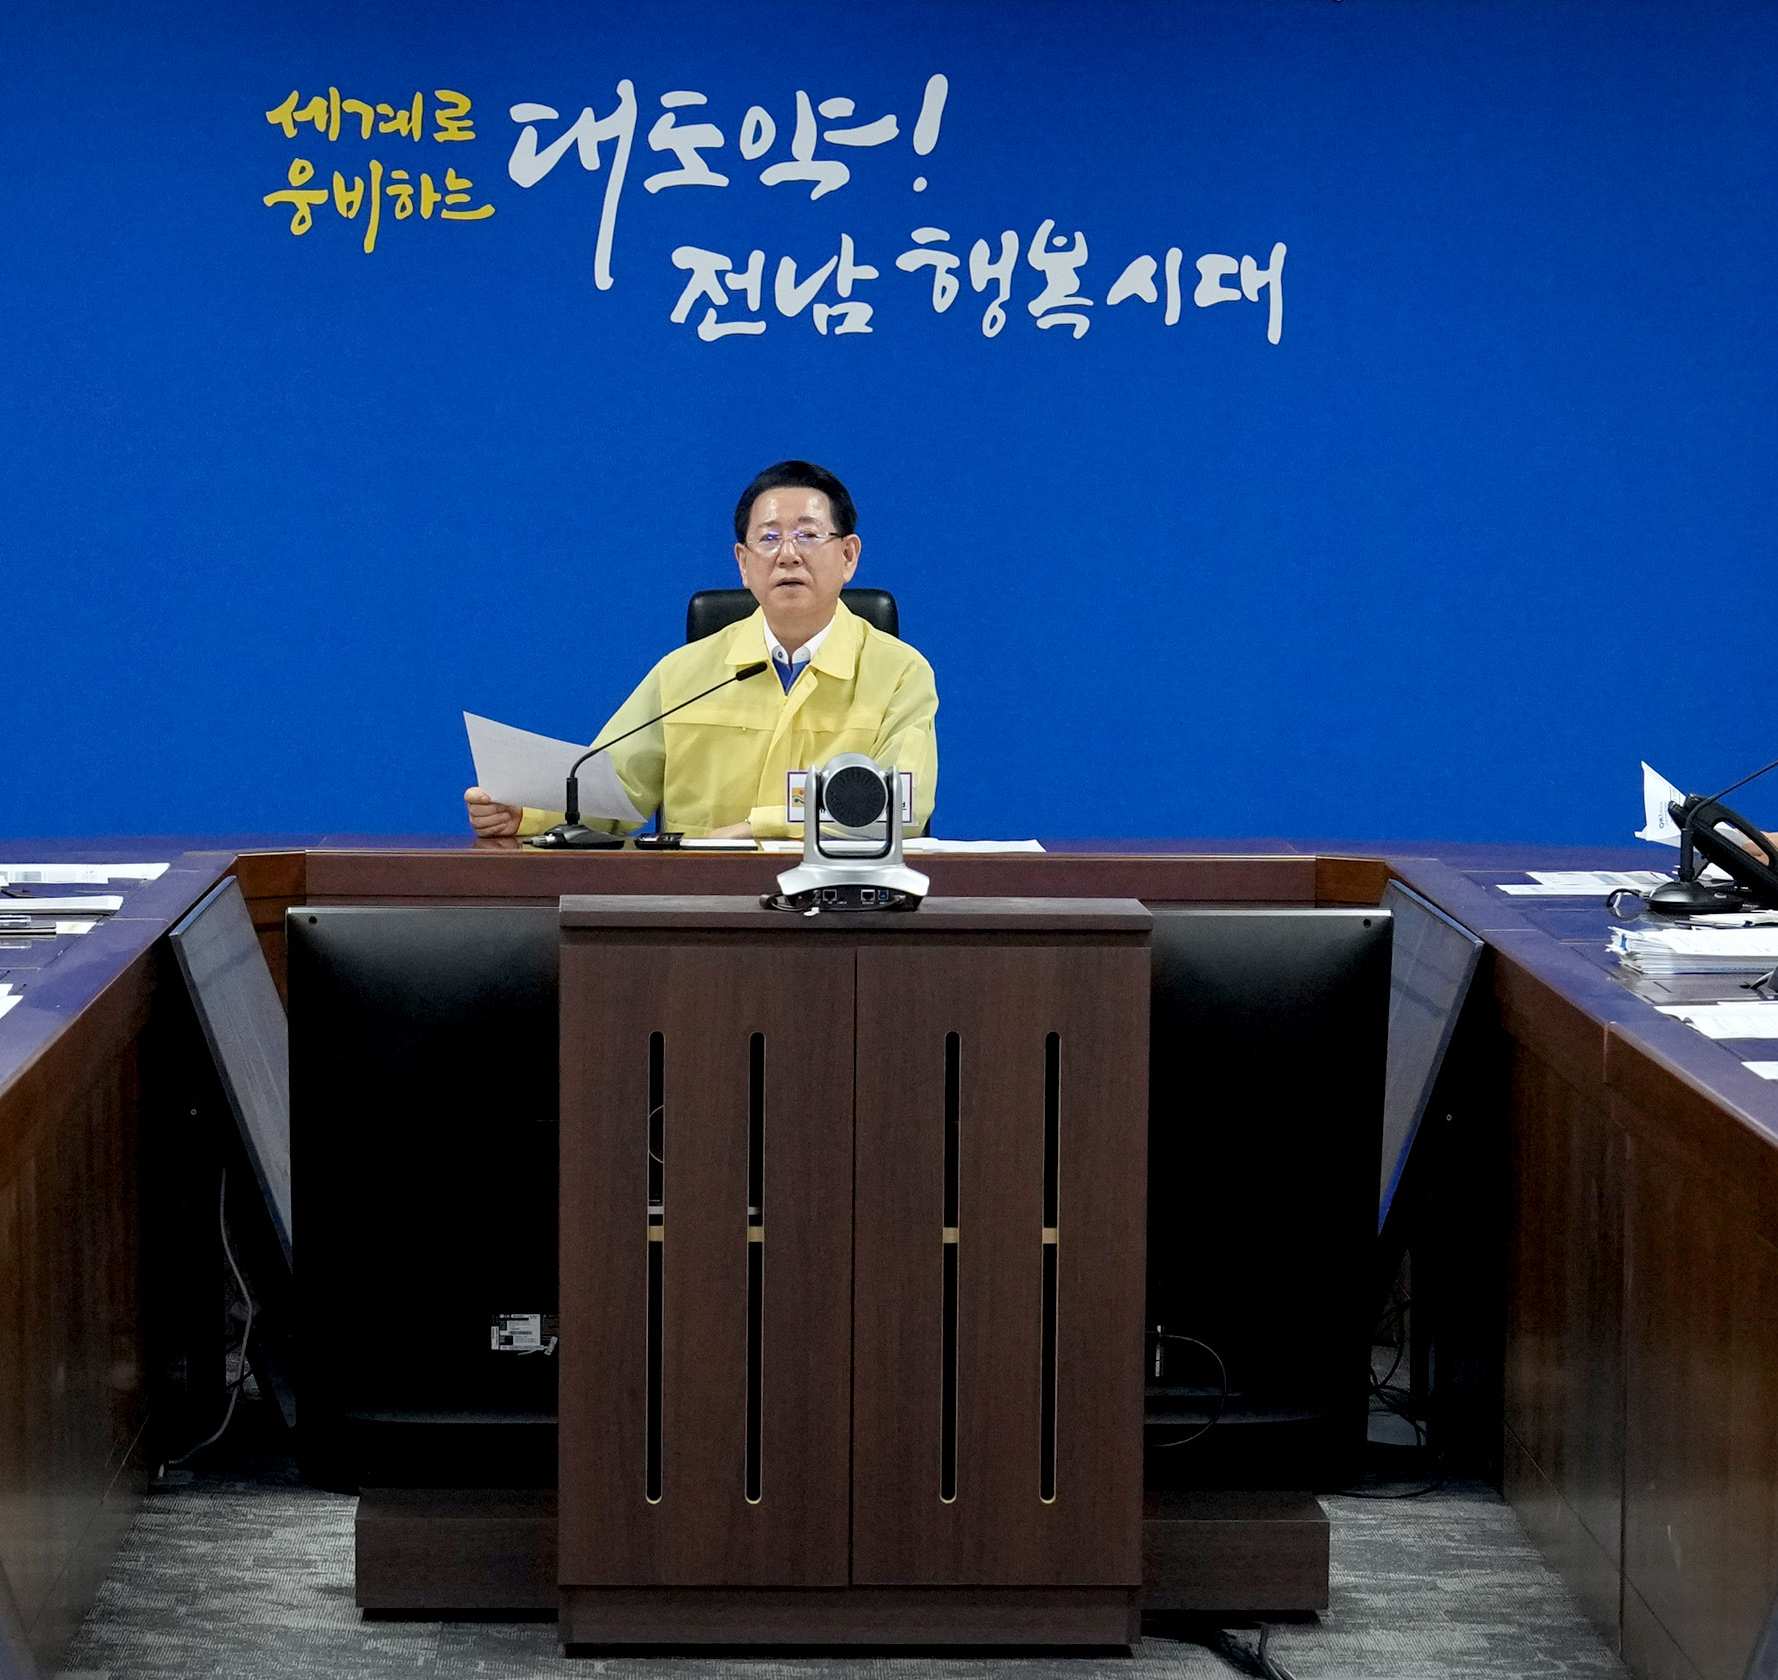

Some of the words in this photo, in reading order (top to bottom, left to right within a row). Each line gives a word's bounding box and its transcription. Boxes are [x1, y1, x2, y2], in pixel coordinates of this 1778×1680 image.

[264, 85, 477, 144] 세계로
[262, 157, 497, 255] 웅비하는
[507, 73, 950, 292] 대도약!
[669, 232, 881, 343] 전남
[894, 218, 1288, 346] 행복시대
